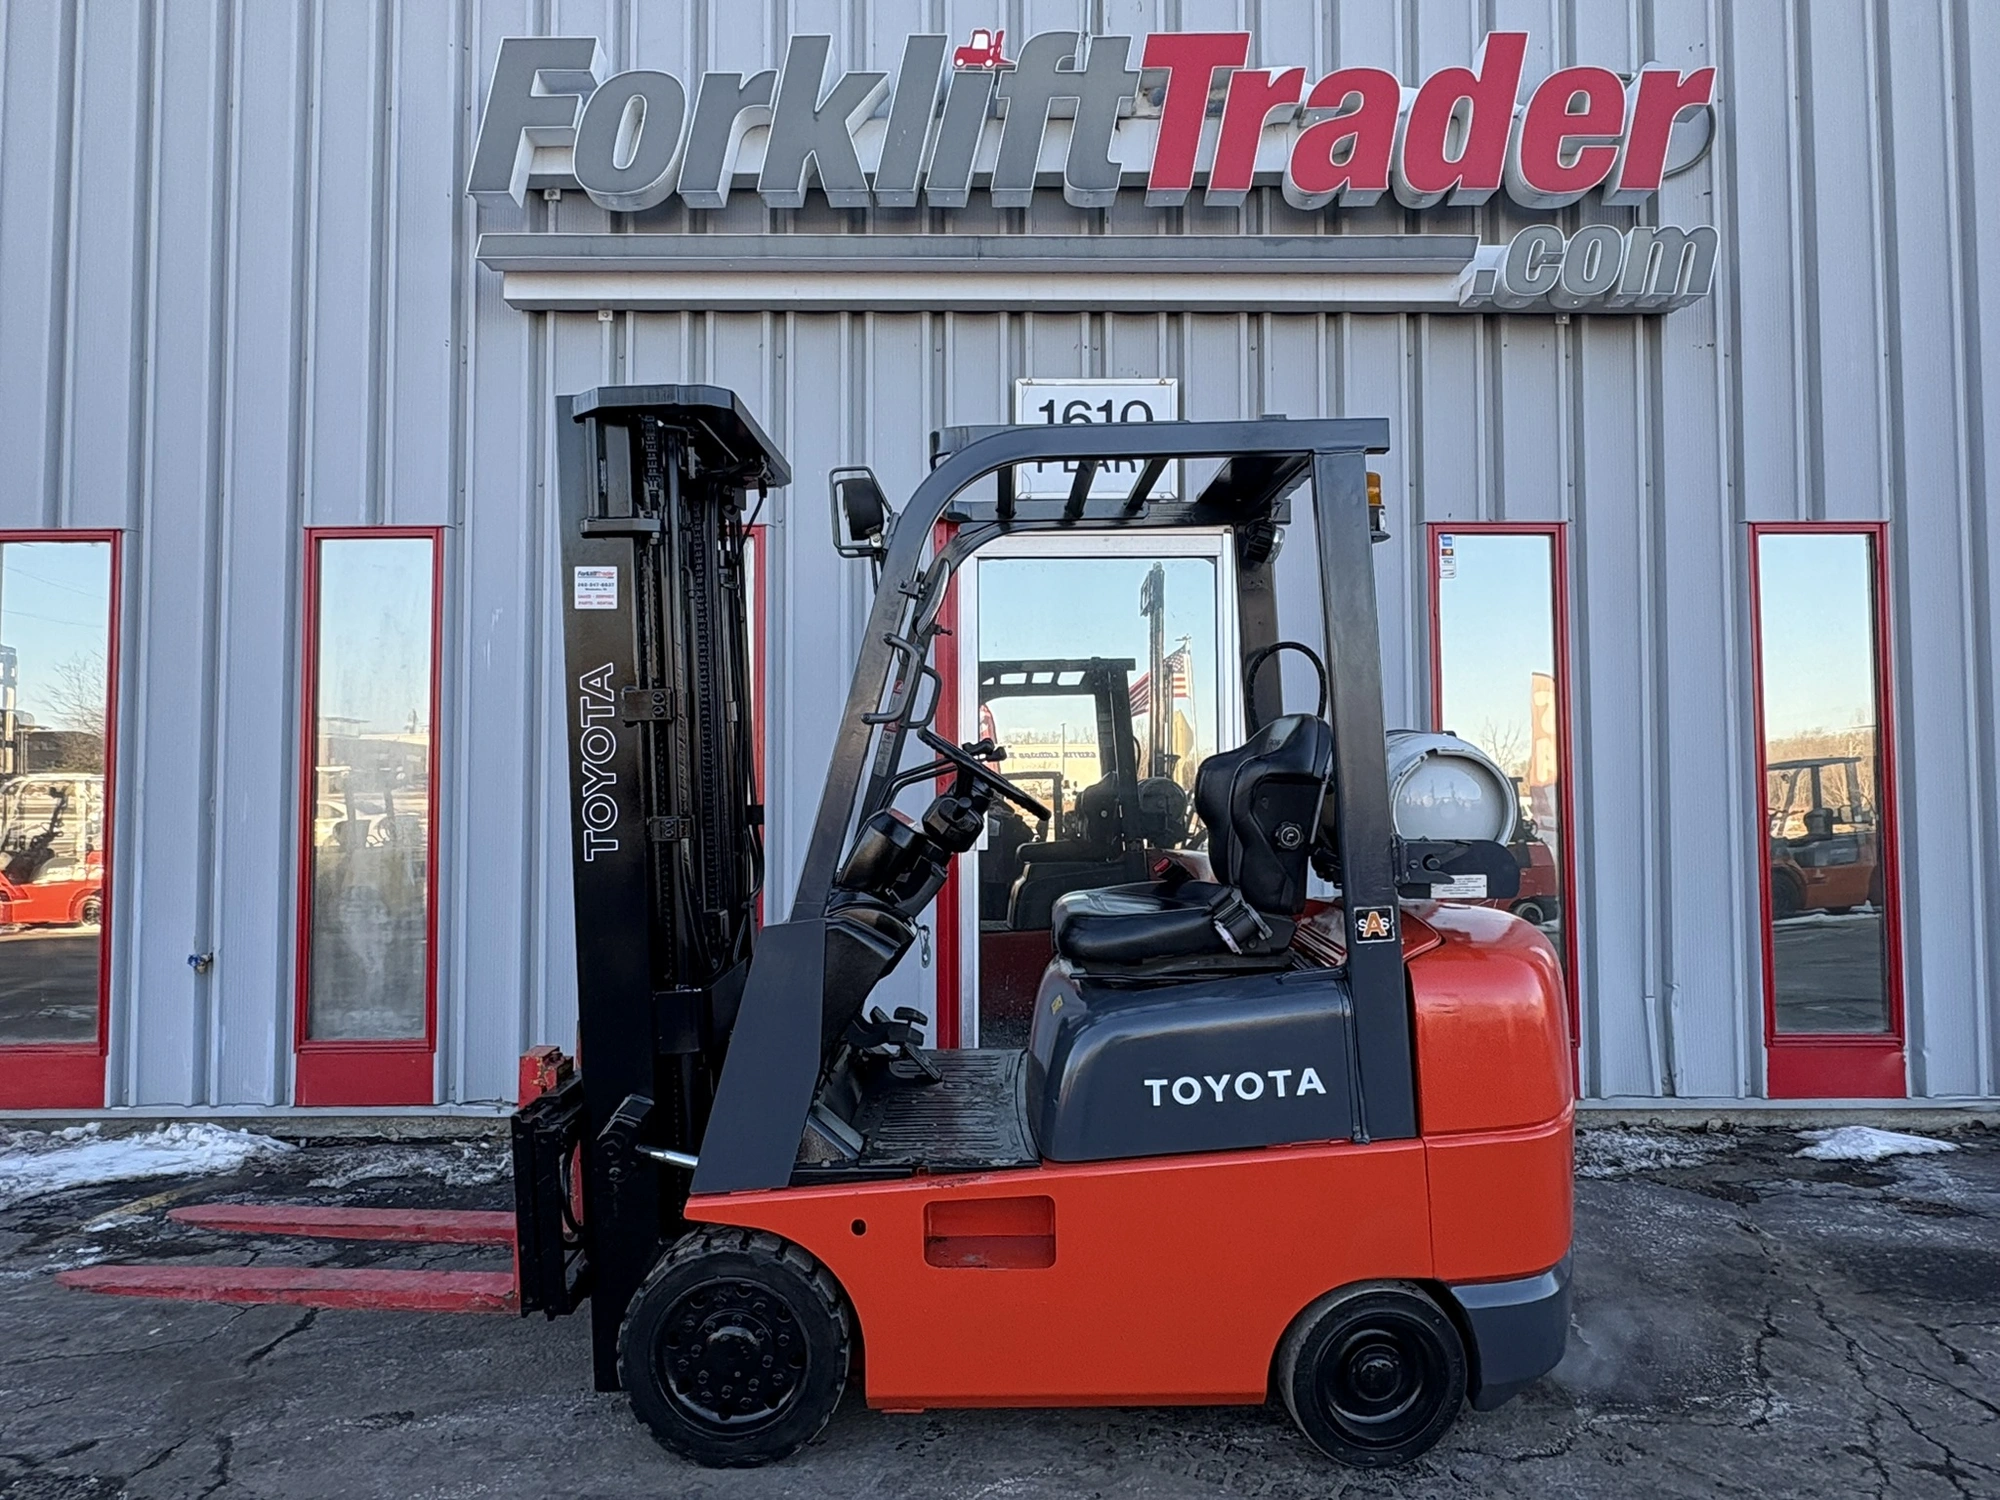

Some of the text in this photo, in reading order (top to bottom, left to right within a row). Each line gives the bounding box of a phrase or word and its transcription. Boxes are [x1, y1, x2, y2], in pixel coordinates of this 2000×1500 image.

[467, 31, 1718, 204] ForkliftTrader
[1468, 224, 1719, 302] .com
[579, 662, 619, 862] TOYOTA
[1357, 911, 1390, 938] SAS
[1144, 1068, 1327, 1107] TOYOTA
